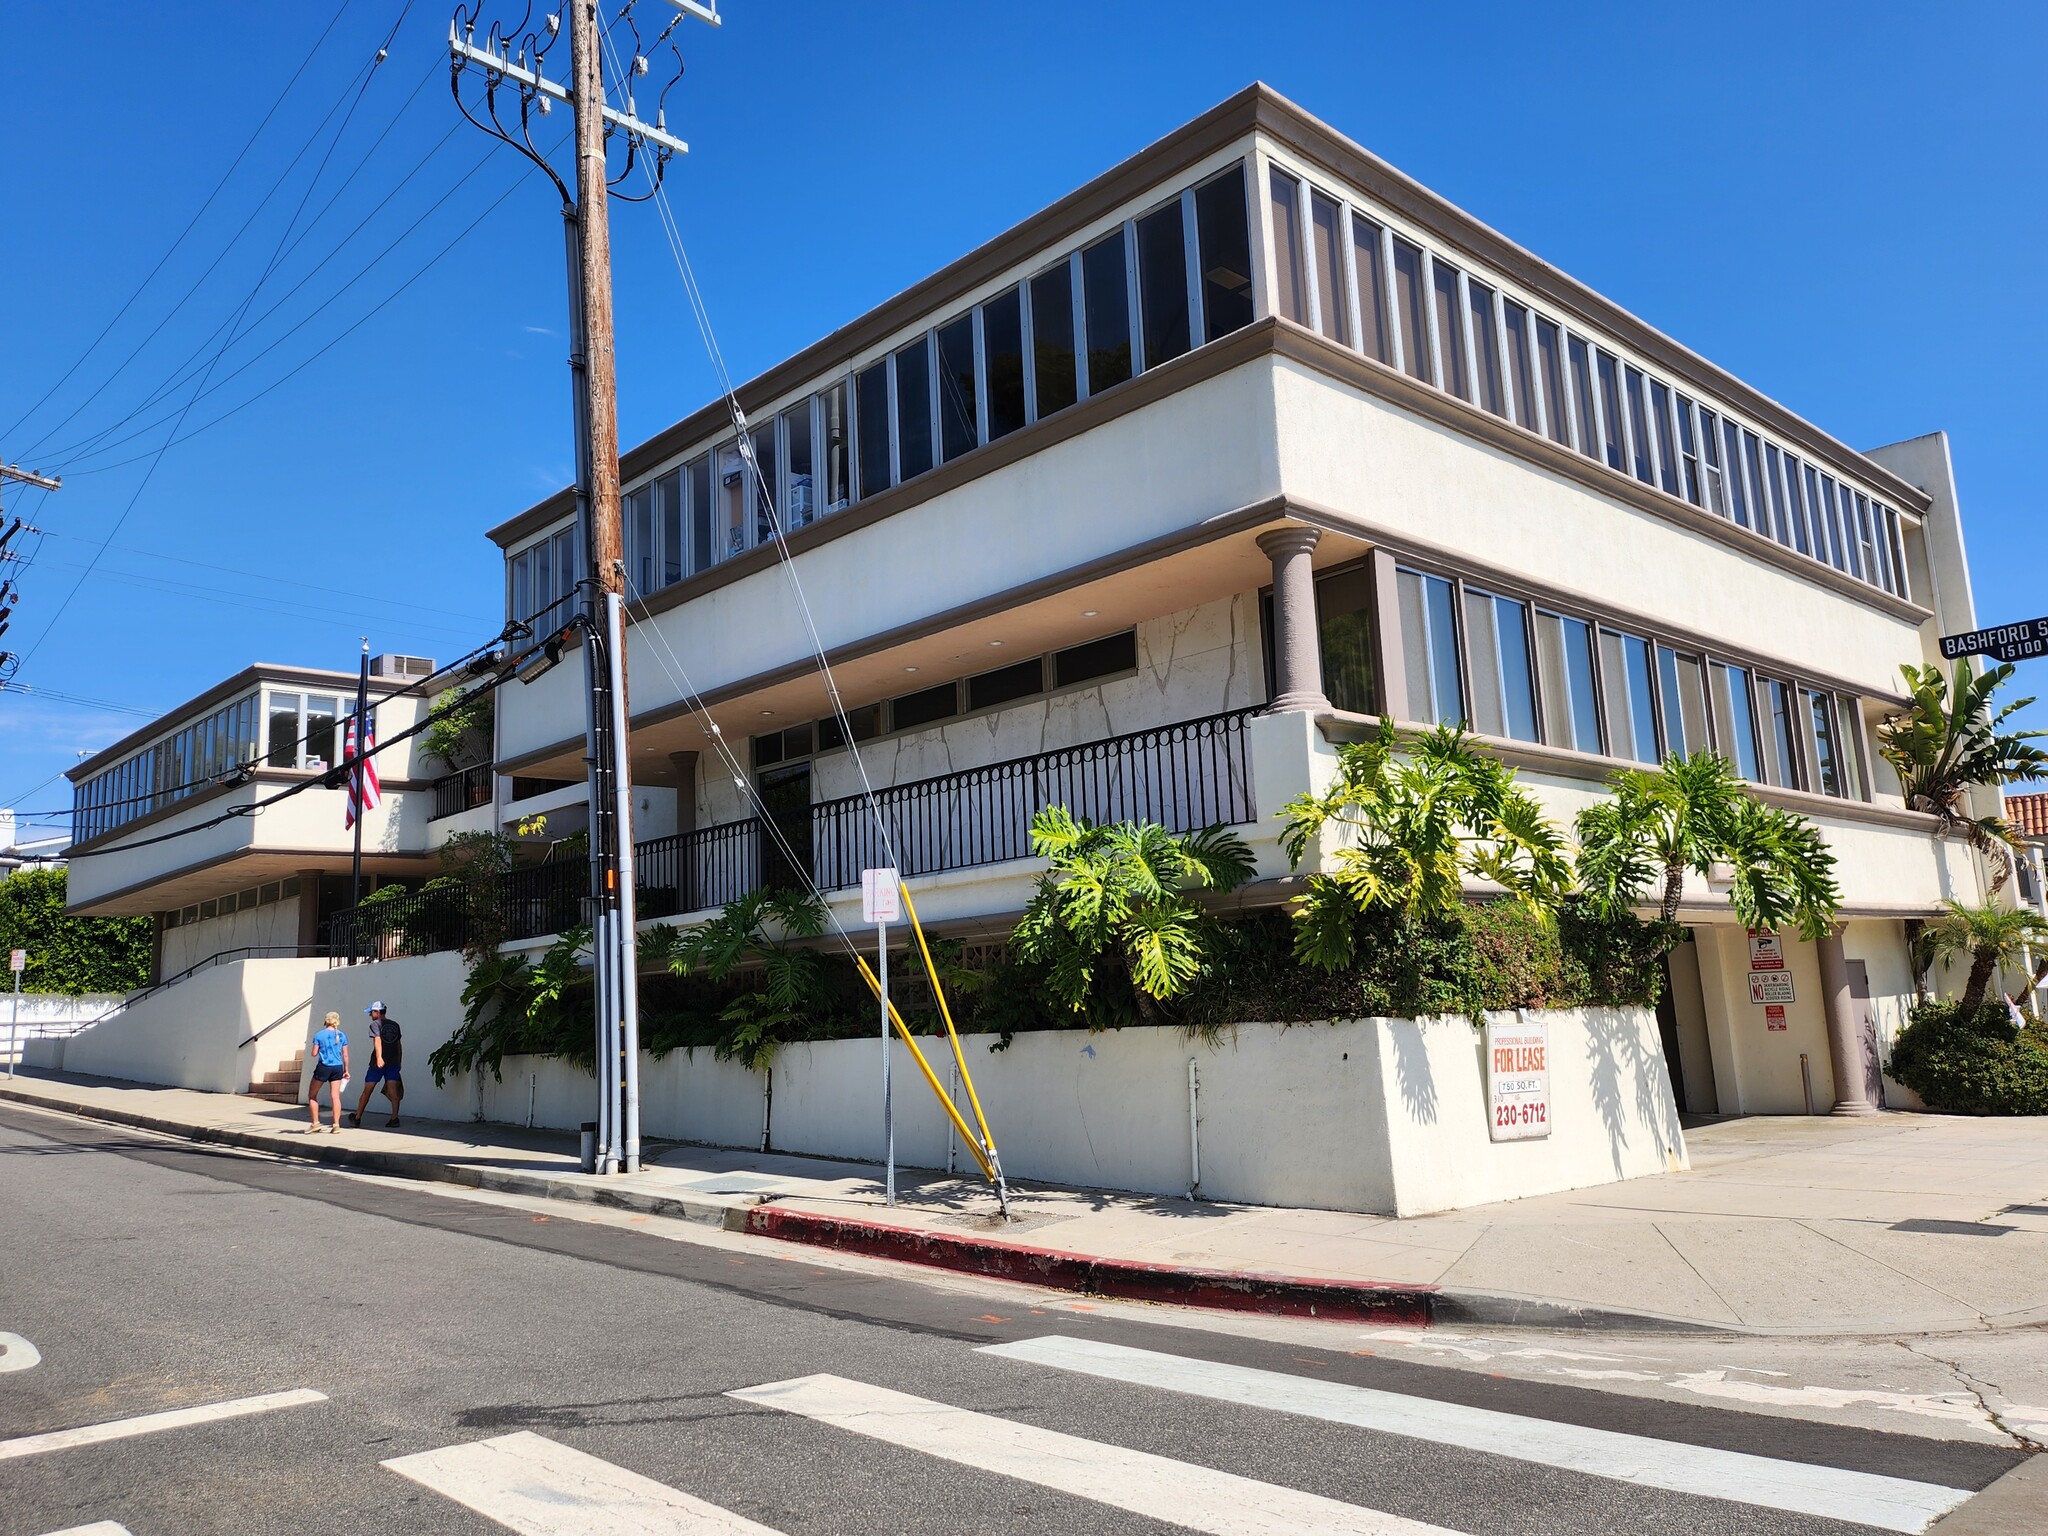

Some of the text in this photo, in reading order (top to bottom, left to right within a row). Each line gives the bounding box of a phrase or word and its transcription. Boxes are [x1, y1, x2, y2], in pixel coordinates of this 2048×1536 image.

[1945, 620, 2048, 655] BASHFORD S
[2001, 639, 2042, 659] 15100
[1752, 984, 1764, 1000] NO
[1494, 1036, 1544, 1046] PROFESSIONAL BUILDING
[1494, 1046, 1545, 1073] FOR LEASE
[1502, 1082, 1515, 1091] 750
[1496, 1102, 1546, 1126] 230-6712
